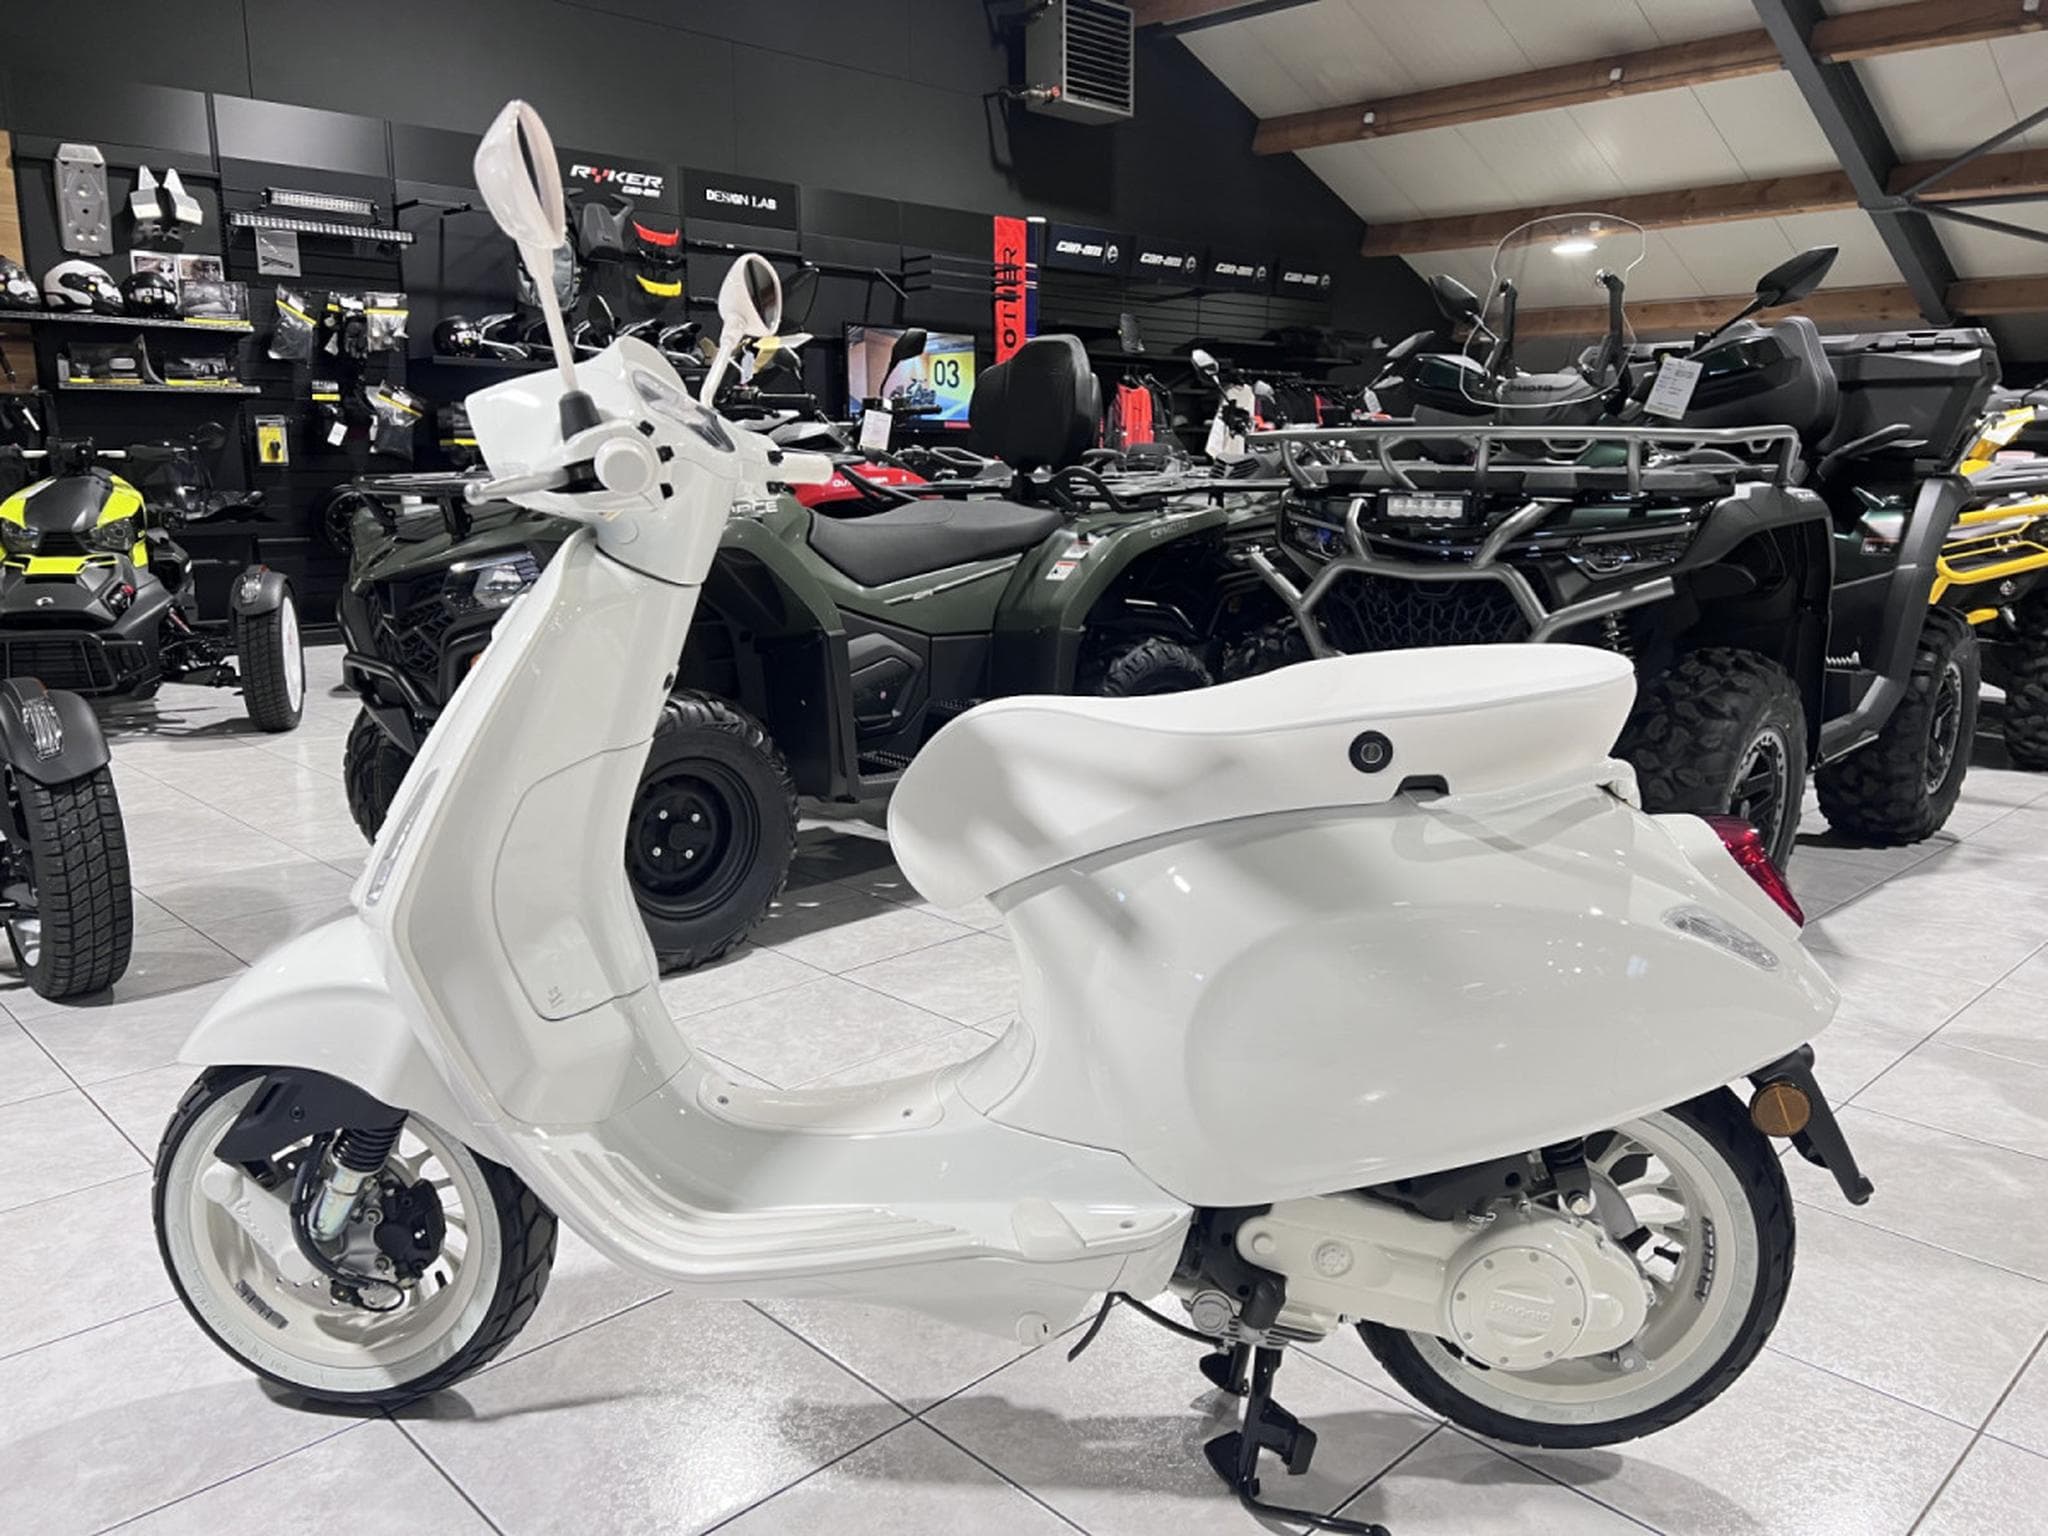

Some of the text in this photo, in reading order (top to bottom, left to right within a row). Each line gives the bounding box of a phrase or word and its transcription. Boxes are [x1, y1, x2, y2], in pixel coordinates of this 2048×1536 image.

[570, 165, 662, 188] RYKER
[706, 189, 776, 210] DESIGN LAB
[934, 360, 959, 388] 03
